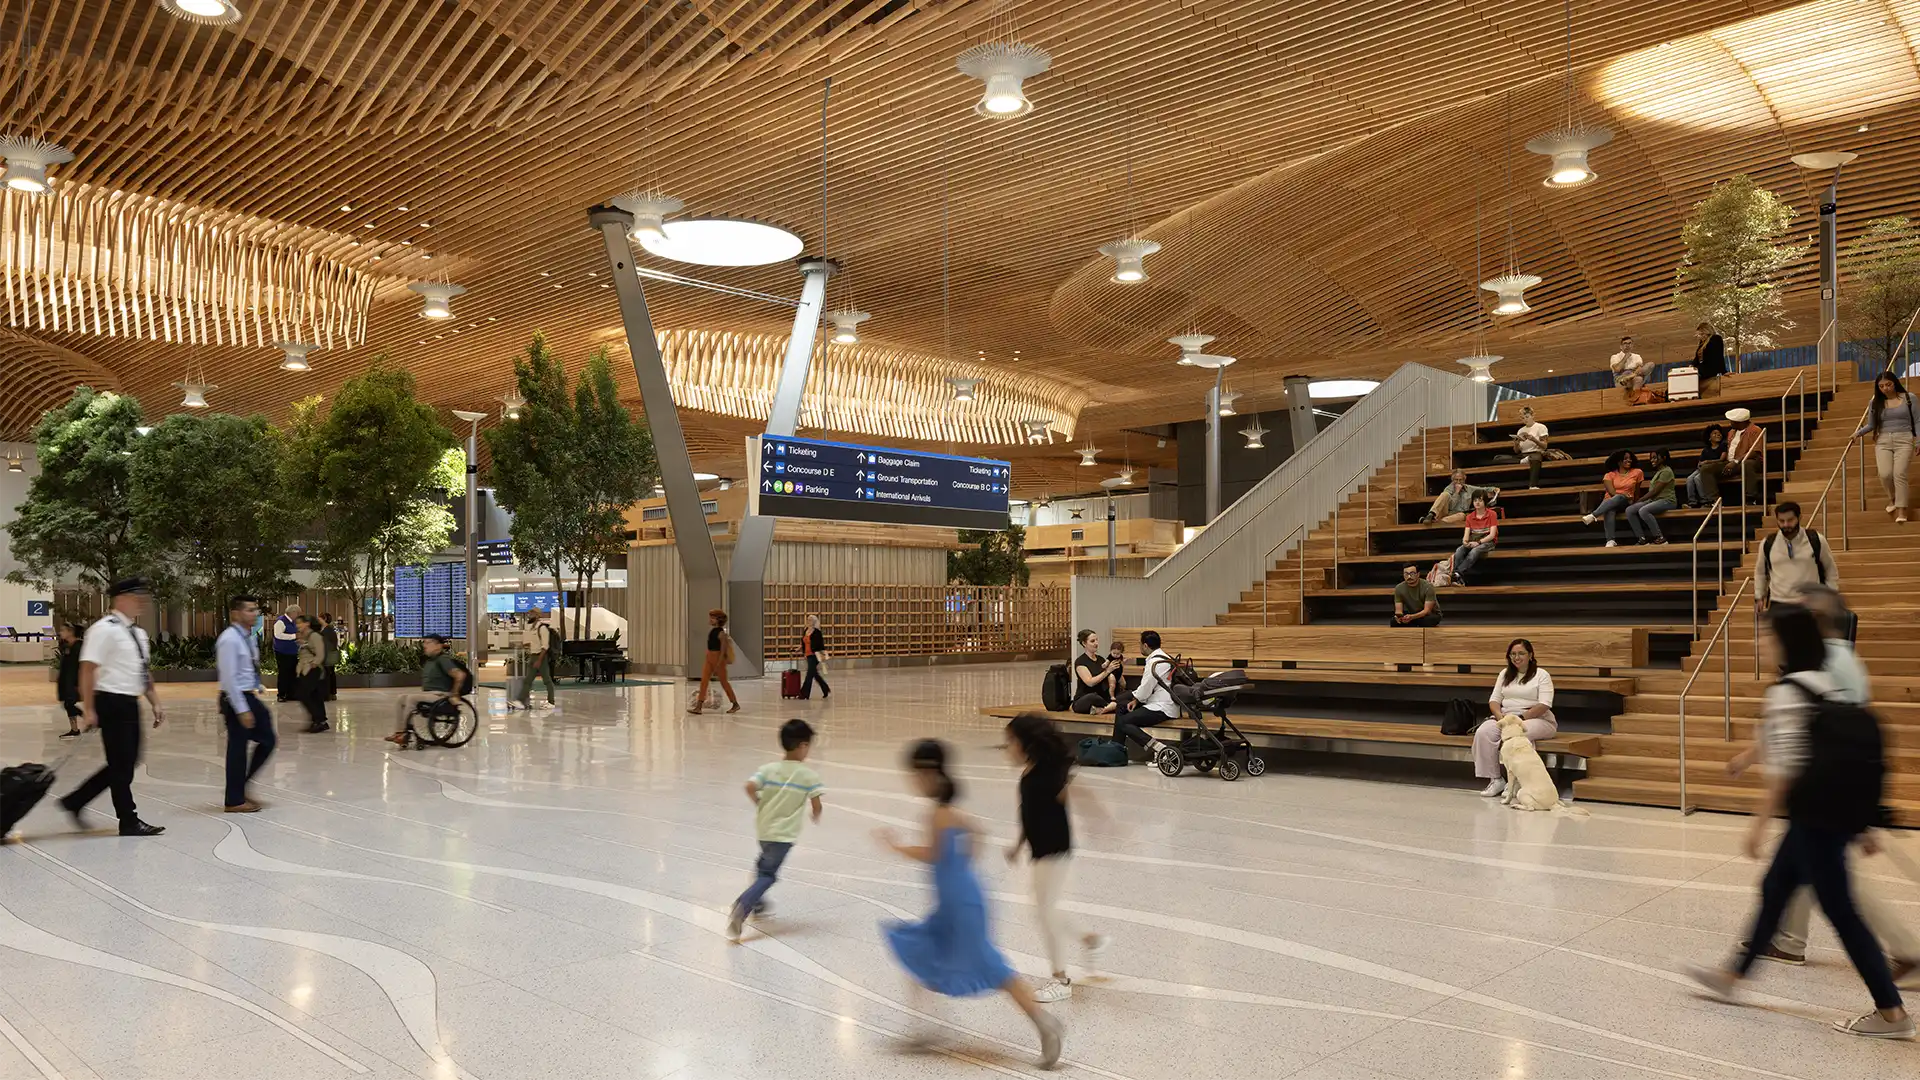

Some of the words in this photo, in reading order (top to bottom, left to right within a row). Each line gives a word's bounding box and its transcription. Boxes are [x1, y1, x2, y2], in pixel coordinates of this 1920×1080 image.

[788, 446, 817, 458] Ticketing
[878, 456, 904, 467] Baggage
[904, 459, 920, 468] Claim
[787, 464, 822, 476] Concourse
[823, 468, 829, 476] D
[829, 469, 835, 477] E
[969, 465, 991, 477] Ticketing
[877, 473, 899, 483] Ground
[900, 475, 939, 486] Transportation
[952, 480, 980, 491] Concourse
[980, 483, 985, 491] B
[805, 484, 829, 496] Parking
[876, 490, 910, 501] International
[910, 493, 931, 503] Arrivals
[33, 602, 43, 614] 2
